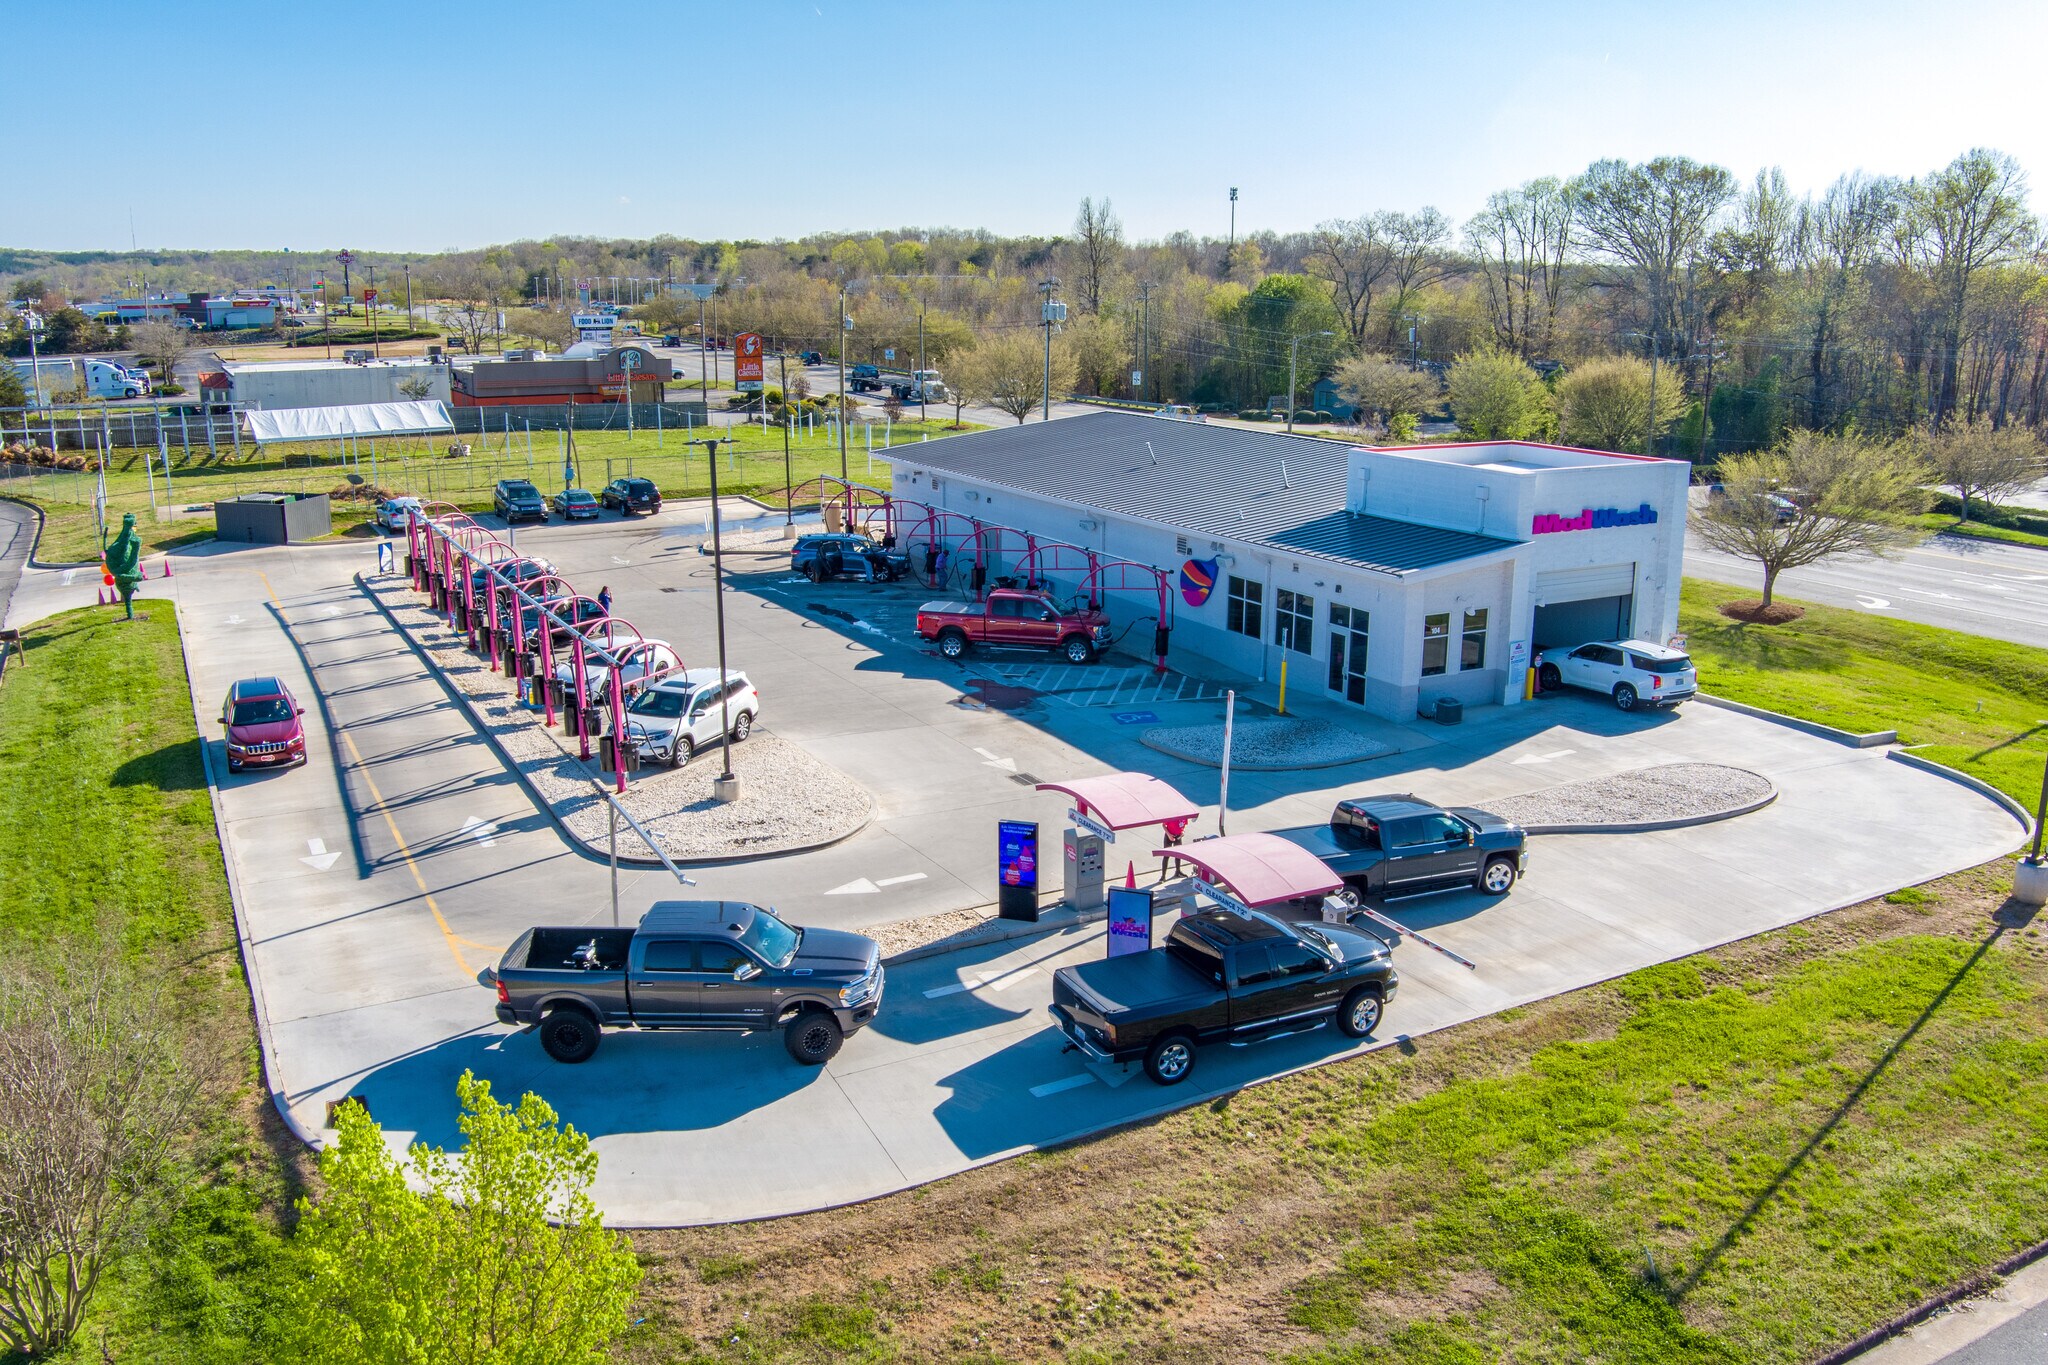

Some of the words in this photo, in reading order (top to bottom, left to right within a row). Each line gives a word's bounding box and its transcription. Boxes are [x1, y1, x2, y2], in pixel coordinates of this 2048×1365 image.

[743, 363, 760, 371] Little
[629, 372, 657, 381] Caesars
[1431, 626, 1441, 634] 104
[1078, 818, 1103, 836] CLEARANCE
[1205, 888, 1236, 911] CLEARANCE
[1236, 906, 1248, 916] 7'2"
[1112, 921, 1146, 932] Mod
[1110, 927, 1148, 939] Wash
